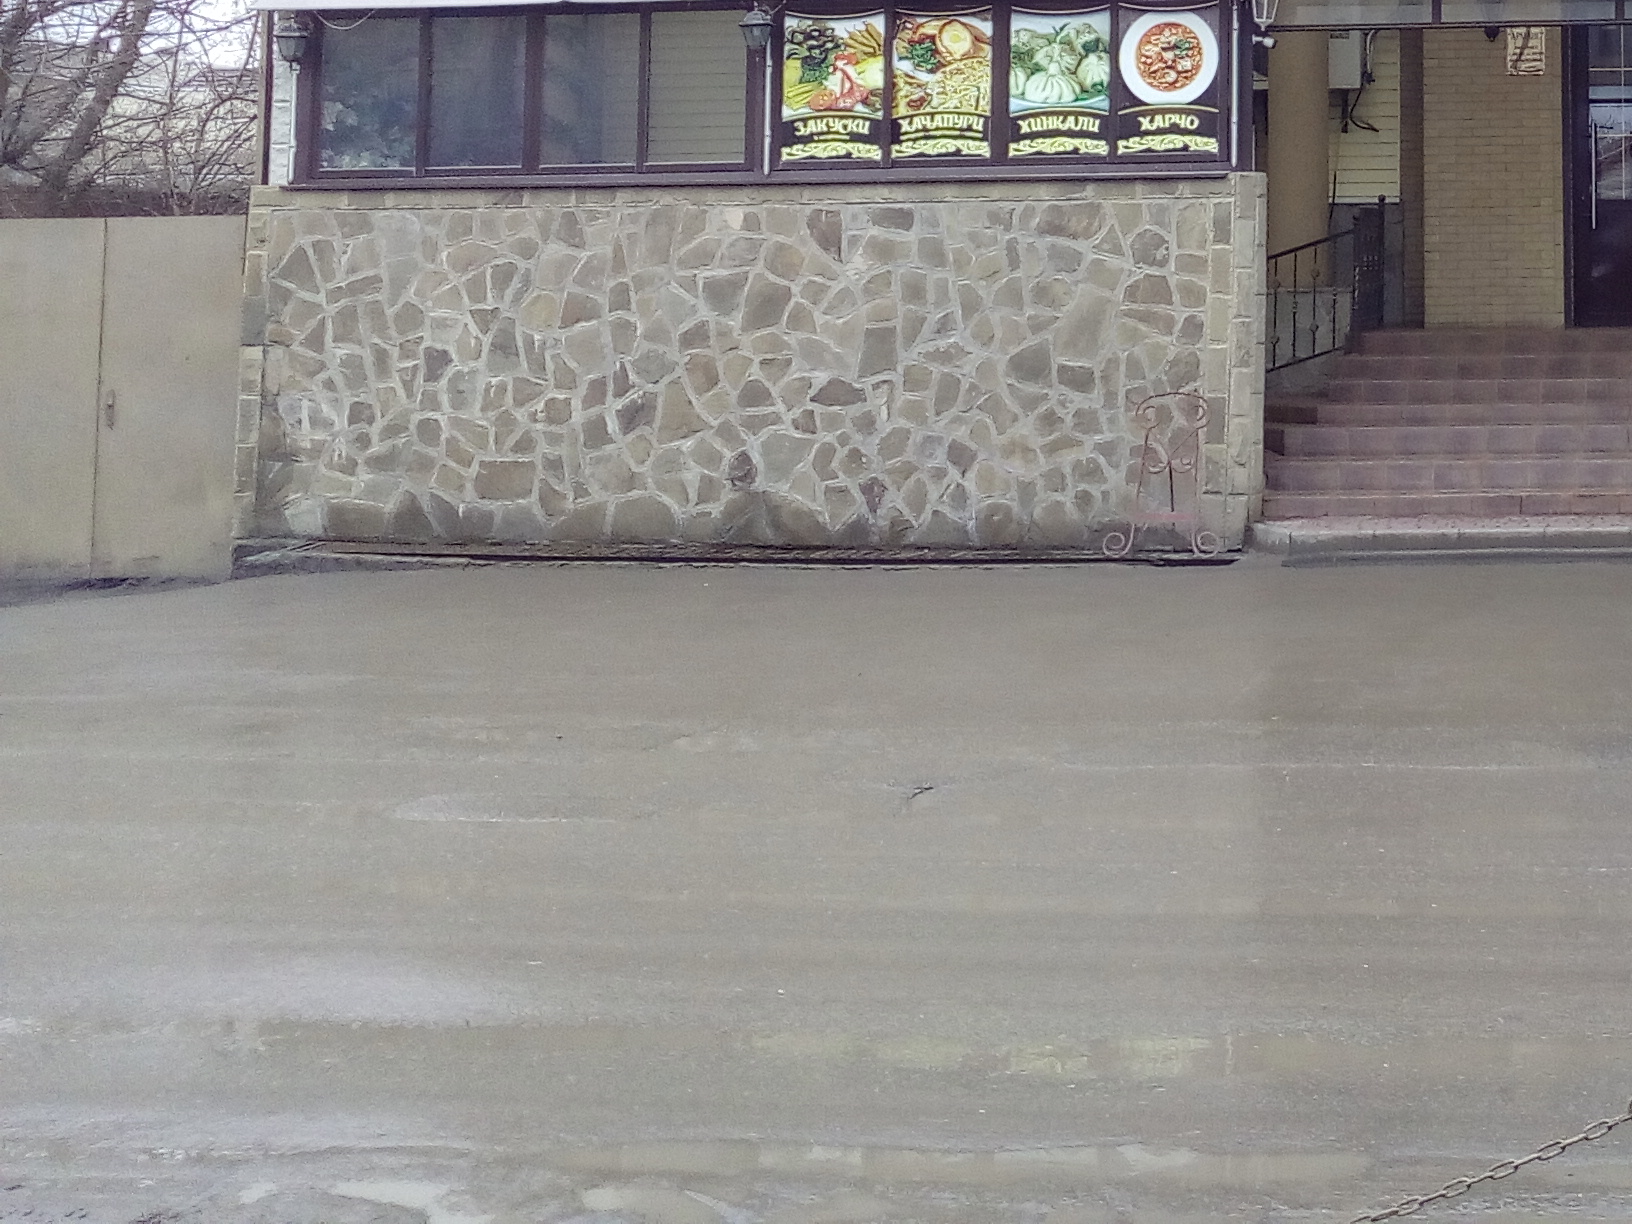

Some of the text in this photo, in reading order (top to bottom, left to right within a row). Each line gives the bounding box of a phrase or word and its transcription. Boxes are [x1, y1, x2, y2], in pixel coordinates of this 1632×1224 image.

[793, 117, 870, 136] ЗАКУСКИ
[898, 114, 985, 133] ХАЧАПУРИ
[1016, 115, 1101, 134] ХИНКАЛИ
[1137, 114, 1200, 131] ХАРЧО
